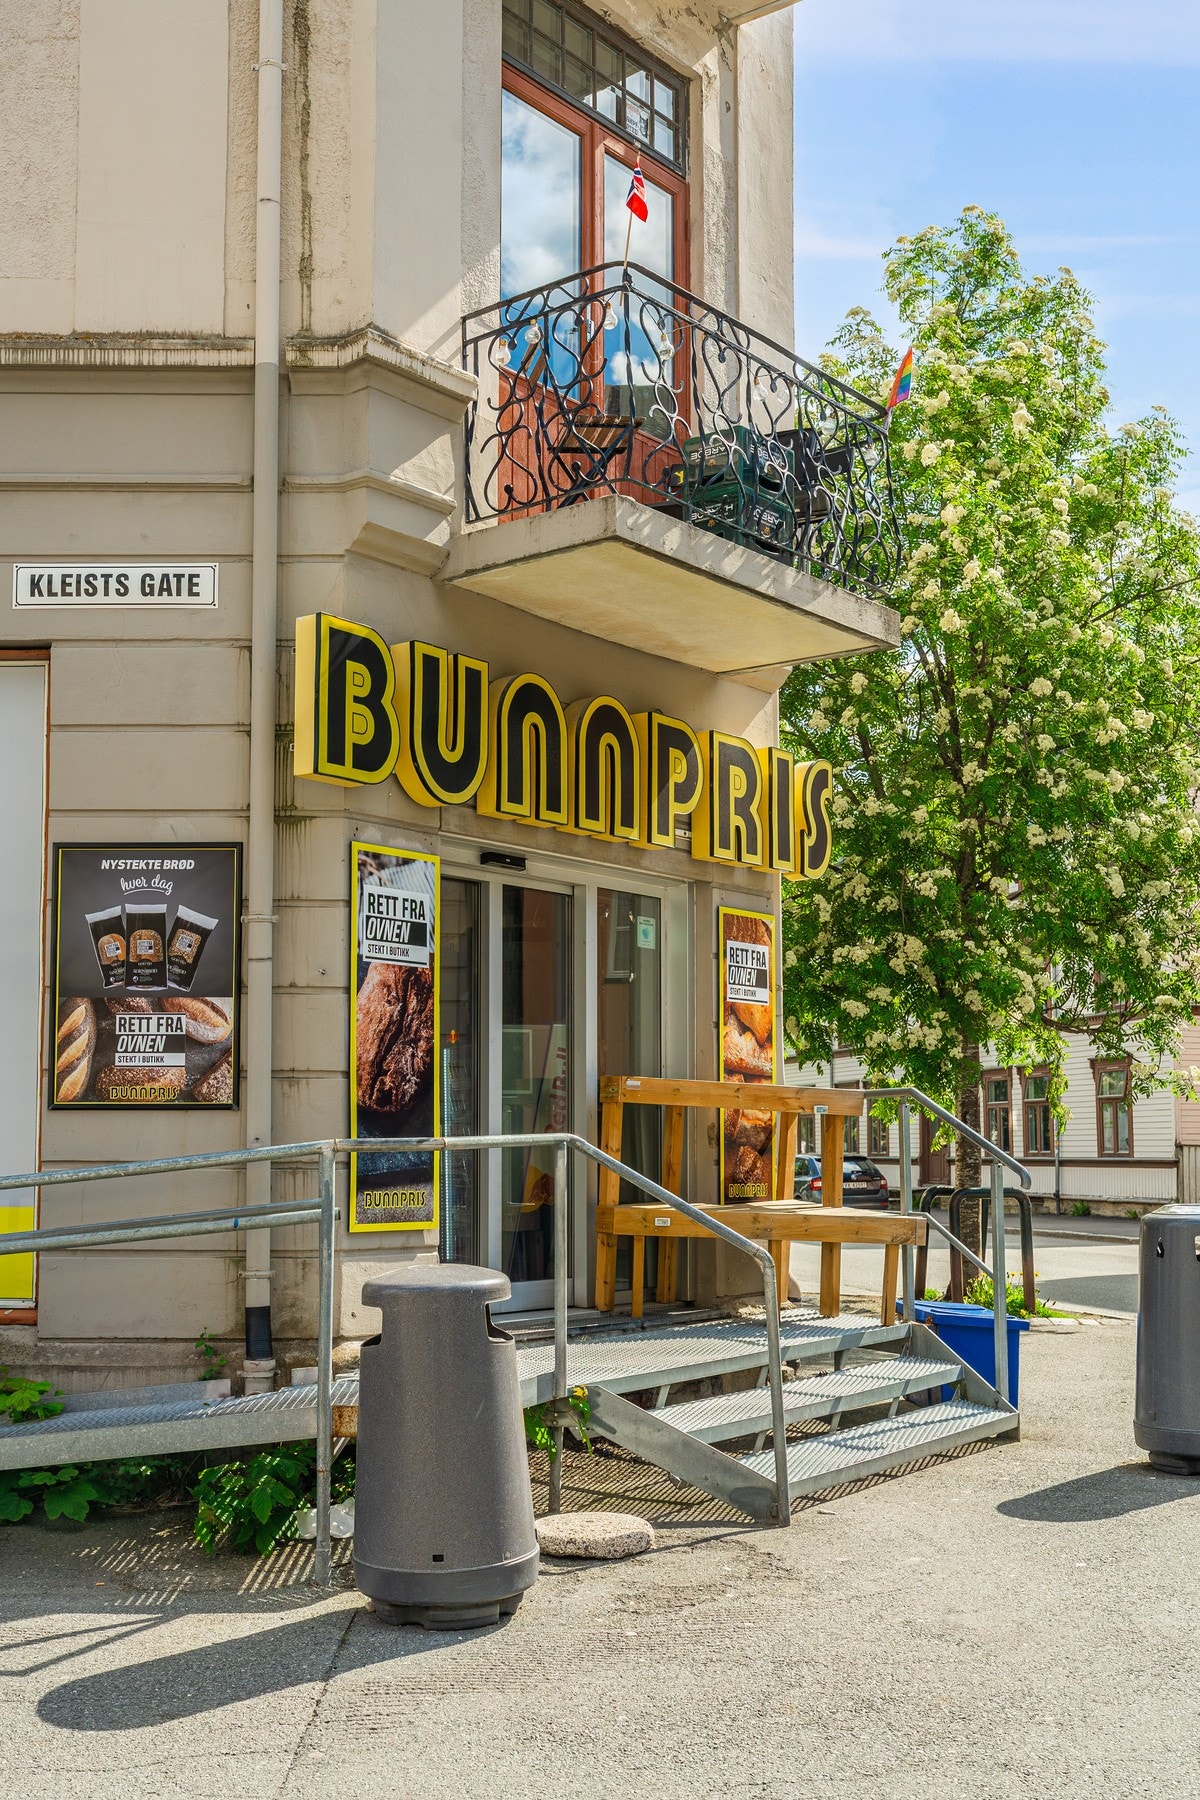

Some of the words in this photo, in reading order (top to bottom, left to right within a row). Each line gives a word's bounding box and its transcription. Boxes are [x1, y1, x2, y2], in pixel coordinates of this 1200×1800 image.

[29, 573, 130, 597] KLEISTS
[140, 573, 201, 597] GATE
[304, 612, 833, 880] BUNNPRIS
[101, 859, 162, 870] NYSTEKTE
[163, 859, 195, 870] BRØD
[120, 876, 148, 891] hver
[151, 873, 174, 896] dag
[367, 892, 399, 917] RETT
[402, 898, 426, 921] FRA
[366, 917, 411, 943] OVNEN
[367, 943, 385, 954] STEKT
[389, 946, 410, 958] BUTIKK
[729, 946, 749, 965] RETT
[751, 950, 767, 968] FRA
[729, 966, 757, 986] OVNEN
[118, 1016, 153, 1033] RETT
[156, 1016, 184, 1033] FRA
[116, 1035, 166, 1052] OVNEN
[117, 1055, 137, 1063] STEKT
[142, 1055, 165, 1063] BUTIKK
[551, 1046, 567, 1092] Bll
[109, 1085, 178, 1100] BUNNPRIS
[364, 1190, 426, 1208] BUNNPRIS
[728, 1182, 769, 1198] BUNNPRIS
